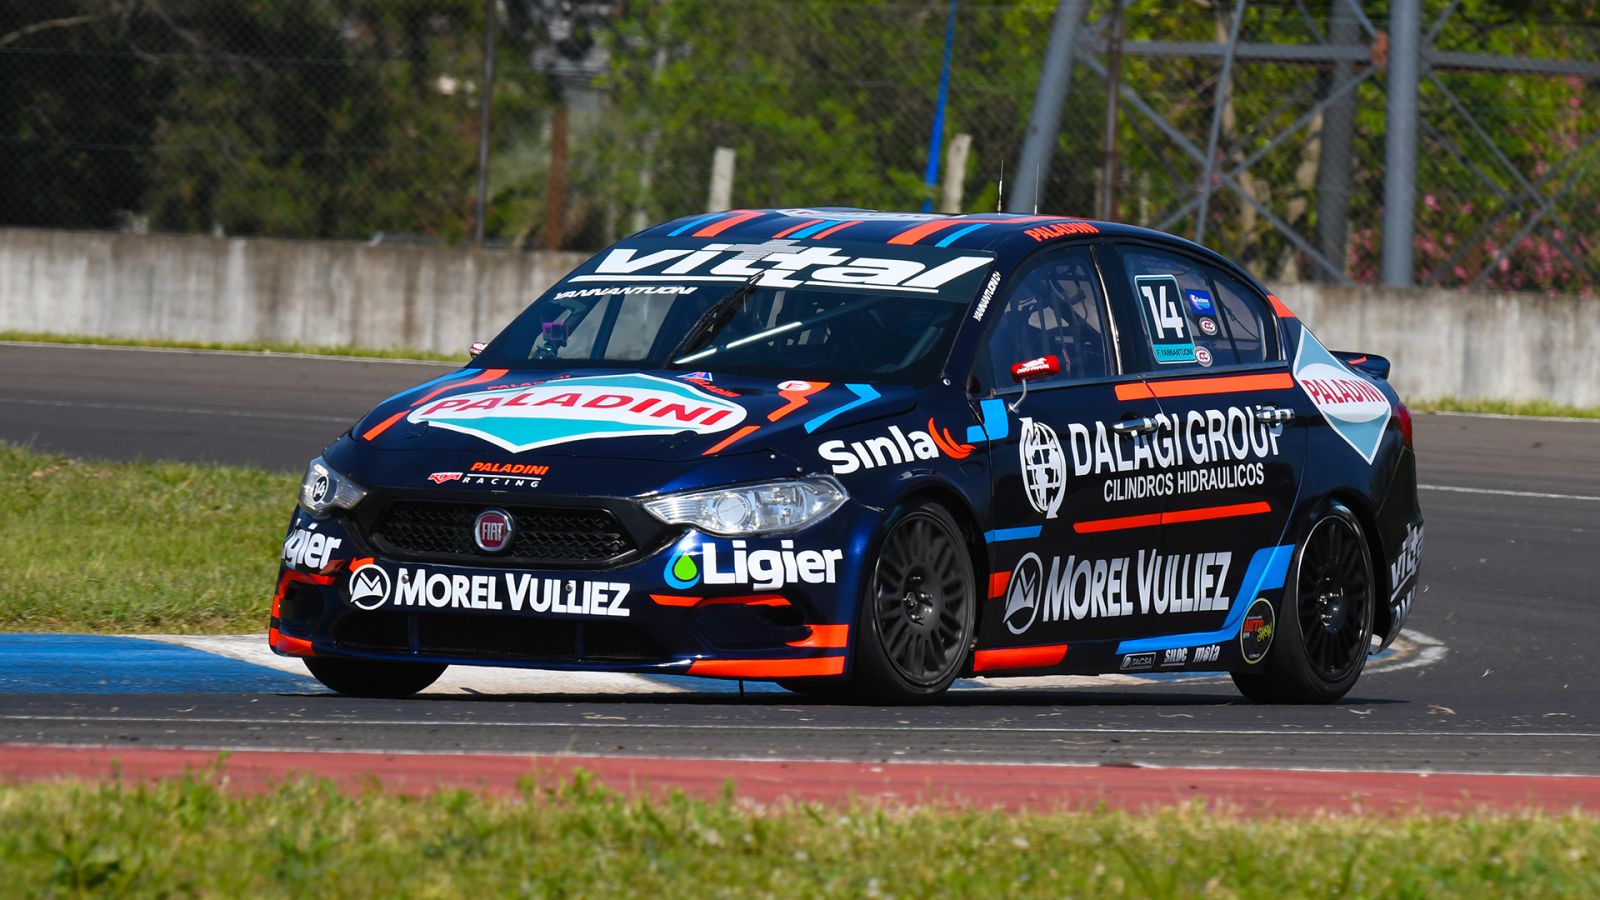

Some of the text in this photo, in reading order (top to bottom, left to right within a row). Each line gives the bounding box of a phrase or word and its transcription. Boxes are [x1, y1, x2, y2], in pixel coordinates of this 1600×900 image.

[1023, 222, 1100, 242] PALADINI
[552, 286, 699, 301] YANNANTUONI
[1140, 286, 1184, 339] 14
[1301, 379, 1386, 406] PALADINI
[420, 392, 734, 426] PALADINI
[1069, 412, 1183, 476] DALAGI
[470, 461, 550, 475] PALADINI
[313, 481, 326, 498] 14
[462, 476, 540, 488] RACING
[1104, 462, 1265, 502] CILINDROS HIDRAULICOS
[482, 522, 504, 541] FIAT
[702, 539, 843, 591] Ligier
